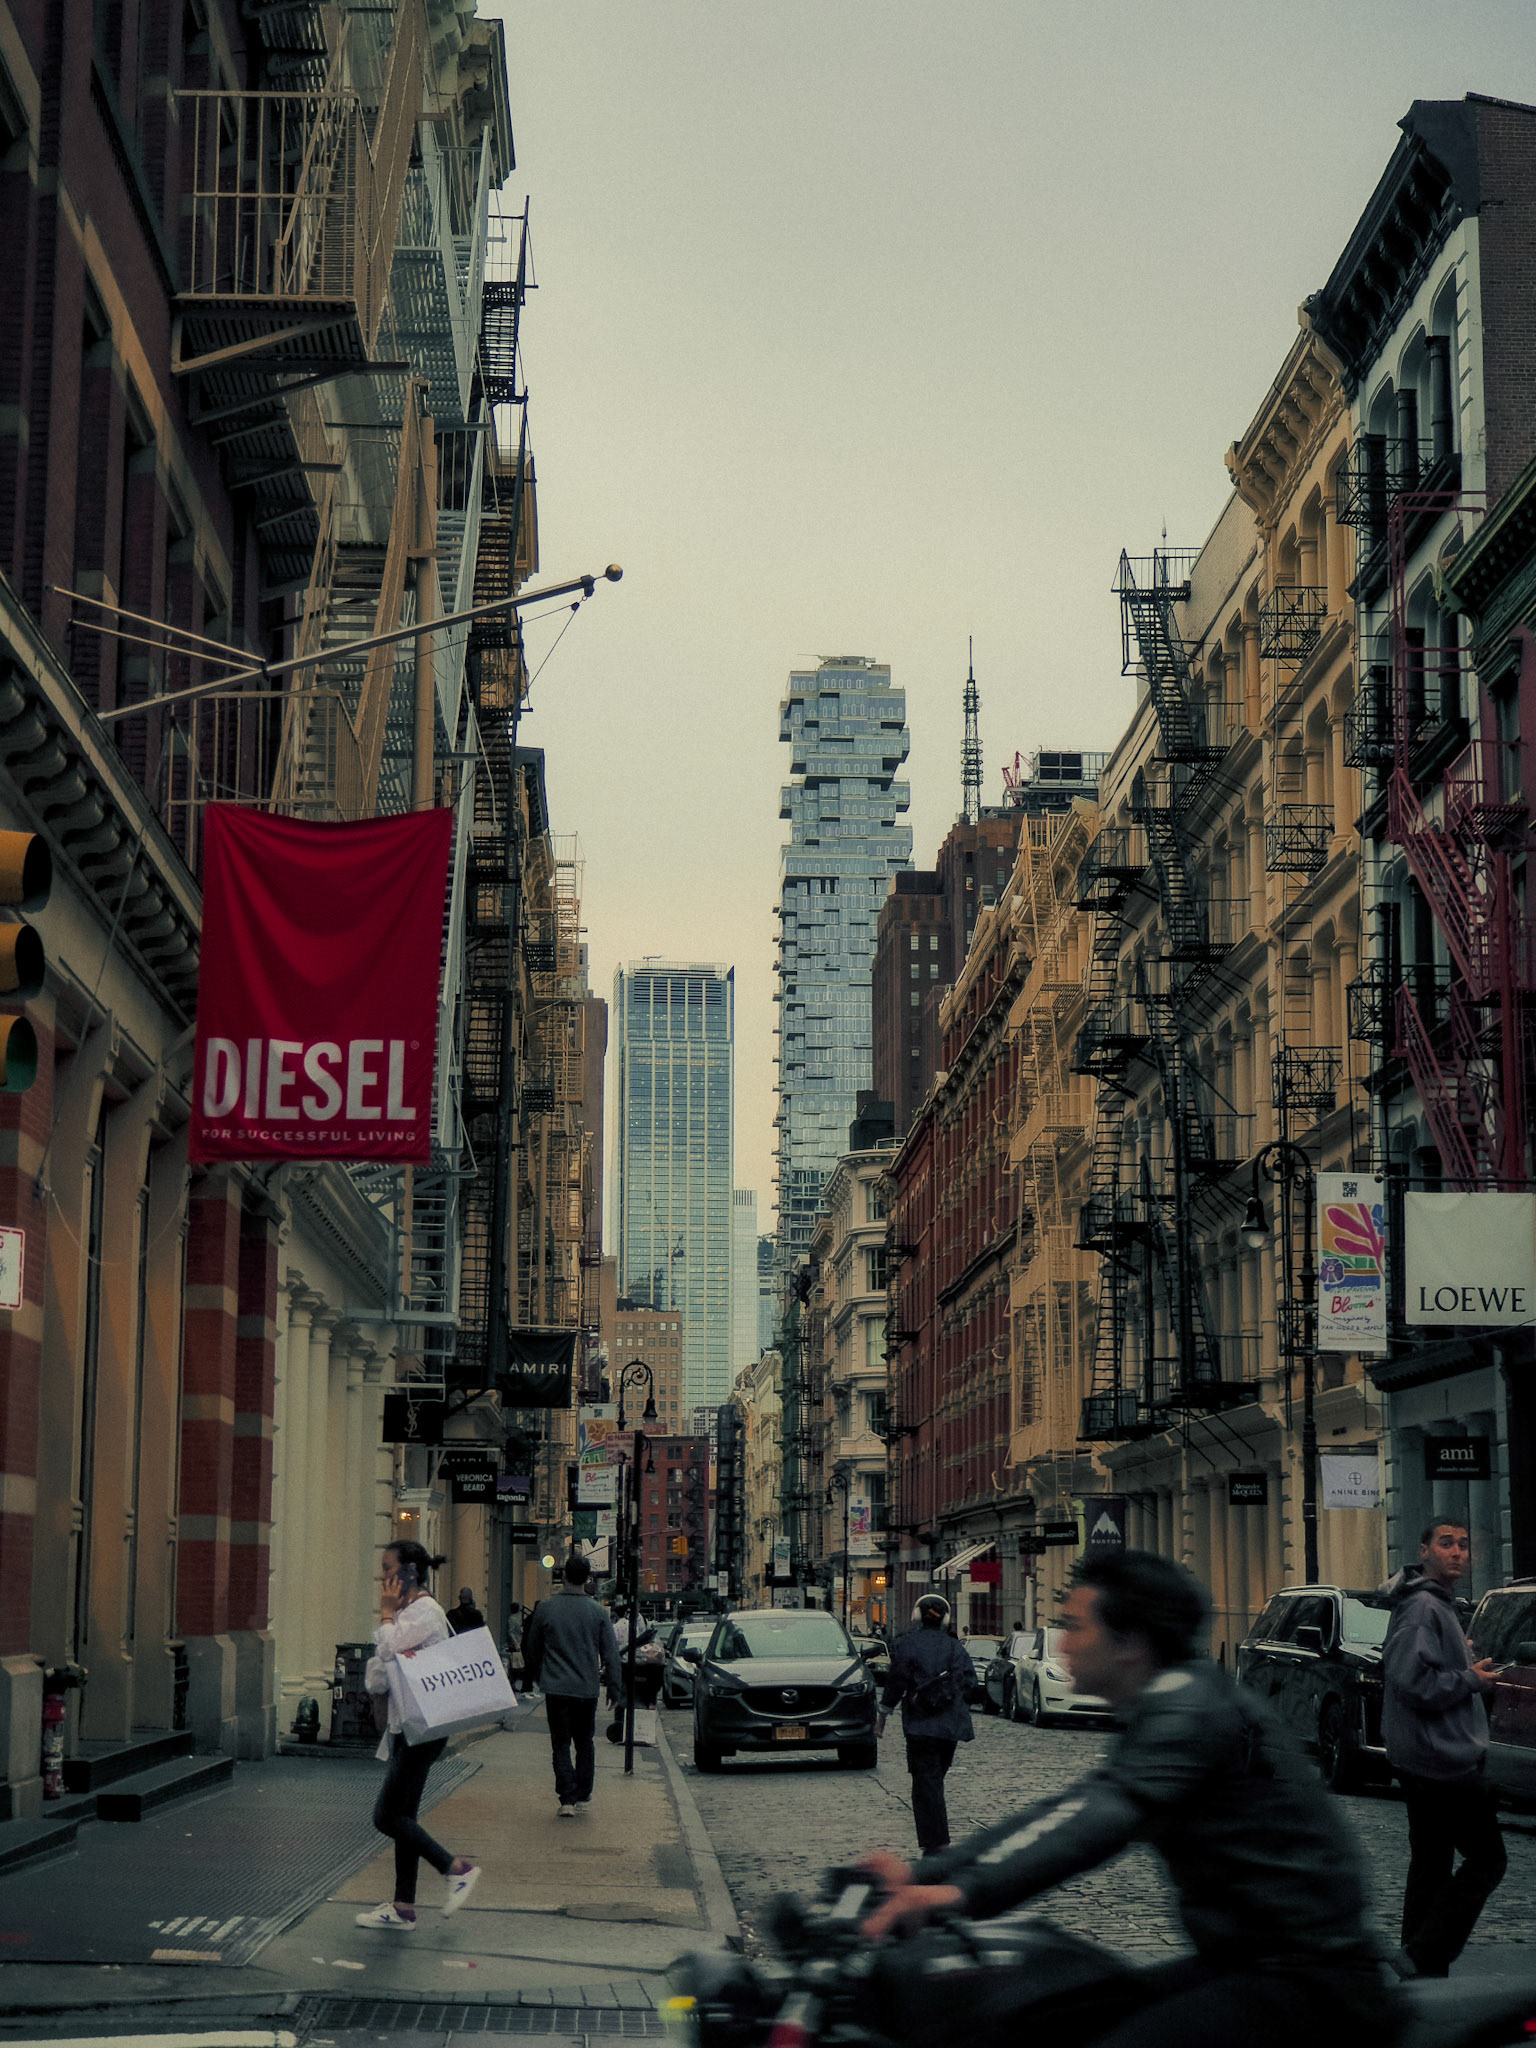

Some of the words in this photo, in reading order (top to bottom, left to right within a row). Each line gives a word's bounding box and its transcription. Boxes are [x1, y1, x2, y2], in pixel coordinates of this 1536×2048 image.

[203, 1037, 417, 1120] DIESEL
[201, 1129, 231, 1140] FOR
[238, 1129, 351, 1141] SUCCESSFUL
[359, 1131, 416, 1141] LIVING
[1420, 1286, 1526, 1312] LOEWE
[509, 1362, 567, 1375] AMIRI
[1440, 1444, 1475, 1460] ami
[456, 1473, 494, 1483] VERONICA
[463, 1483, 486, 1492] BEARD
[496, 1494, 526, 1502] tagonia
[421, 1660, 495, 1692] BYREDO
